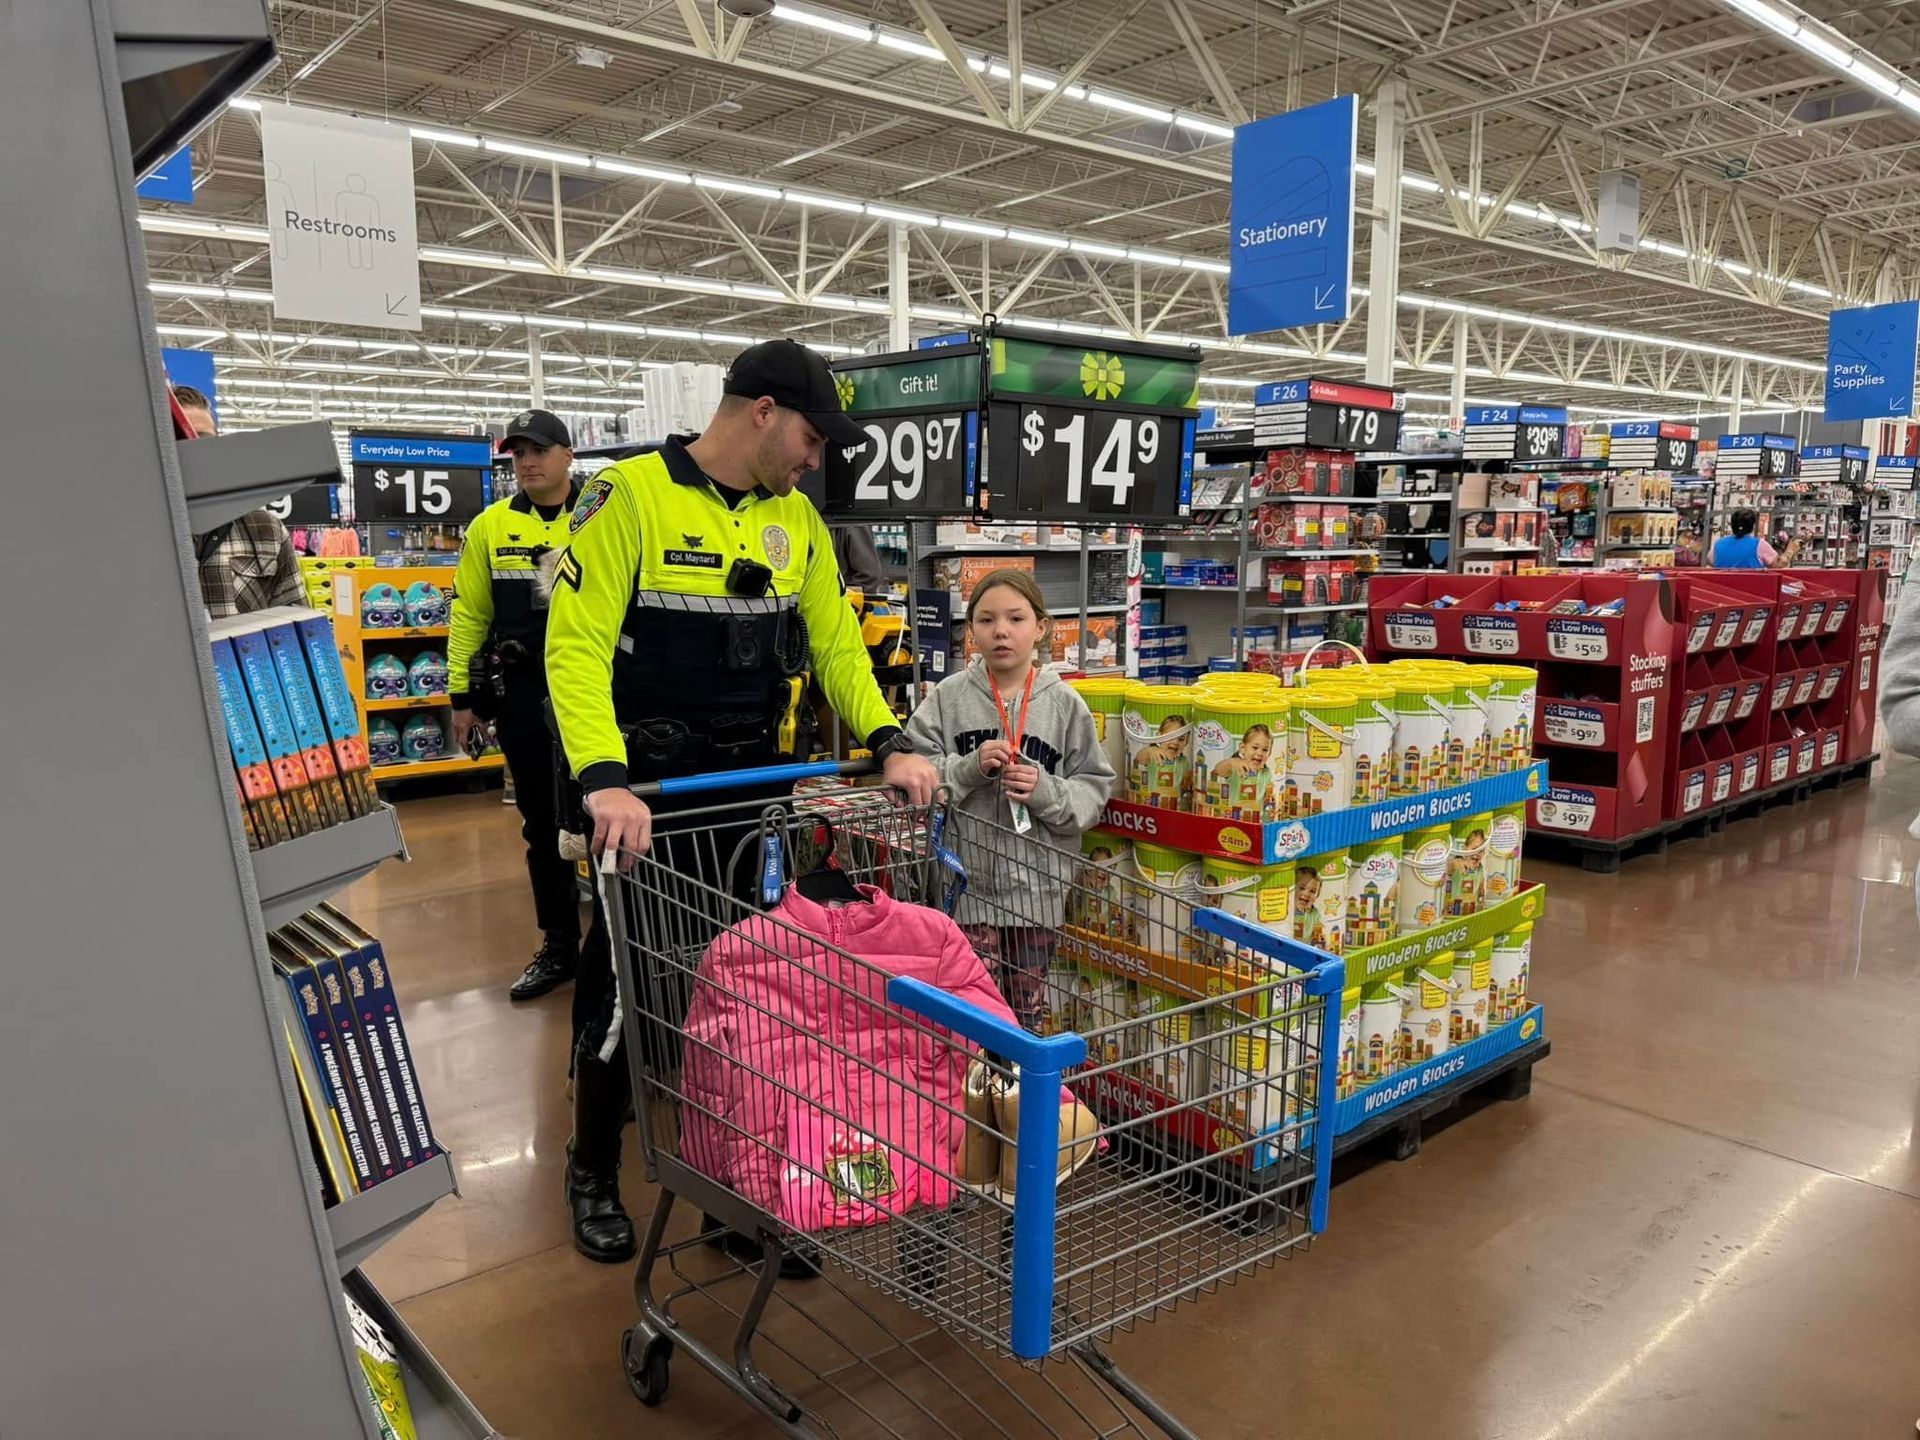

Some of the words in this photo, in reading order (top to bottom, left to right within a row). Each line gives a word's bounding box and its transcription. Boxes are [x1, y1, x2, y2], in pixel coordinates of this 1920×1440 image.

[285, 210, 396, 243] Restrooms
[1240, 217, 1328, 247] Stationery
[1834, 363, 1867, 376] Party
[900, 376, 923, 394] Gift
[925, 373, 938, 392] it!
[1833, 375, 1885, 390] Supplies
[1282, 384, 1298, 400] 26
[1481, 410, 1489, 422] F
[1492, 410, 1508, 421] 24
[1626, 424, 1634, 435] F
[1635, 424, 1649, 435] 22
[1732, 437, 1740, 447] F
[1741, 436, 1755, 446] 20
[360, 444, 404, 457] Everyday
[406, 446, 426, 456] Low
[427, 447, 450, 457] Price
[1814, 448, 1821, 456] F
[1822, 447, 1832, 456] 18
[1889, 458, 1897, 466] F
[1898, 457, 1906, 466] 16
[670, 552, 684, 563] Cpl.
[685, 553, 716, 564] Maynard
[1397, 616, 1413, 624] Low
[1414, 616, 1434, 625] Price
[1476, 620, 1493, 629] Low
[1494, 620, 1517, 630] Price
[1561, 623, 1580, 632] Low
[1582, 624, 1605, 634] Price
[1859, 623, 1879, 638] Stocking
[1859, 637, 1877, 653] stuffers
[1629, 651, 1667, 673] Stocking
[277, 650, 293, 685] LAURIE
[288, 686, 306, 727] GILMORE
[311, 641, 327, 675] LAURIE
[321, 676, 339, 727] GILMORE
[1630, 672, 1664, 693] stuffers
[246, 657, 262, 693] LAURIE
[258, 693, 277, 737] GILMORE
[1558, 708, 1577, 718] Low
[1578, 710, 1602, 721] Price
[223, 702, 243, 745] GILMORE
[1552, 790, 1570, 800] Low
[1571, 793, 1594, 804] Price
[1370, 804, 1425, 831] Wooden
[1220, 835, 1250, 848] 24m+
[767, 838, 777, 878] Walmart
[1366, 944, 1421, 974] Wooden
[388, 1020, 406, 1062] POKÉMON
[398, 1060, 418, 1105] STORYBOOK
[411, 1103, 431, 1149] COLLECTION
[345, 1037, 365, 1079] POKÉMON
[357, 1077, 379, 1122] STORYBOOK
[370, 1121, 391, 1166] COLLECTION
[368, 1029, 387, 1070] POKÉMON
[379, 1069, 400, 1114] STORYBOOK
[391, 1113, 412, 1158] COLLECTION
[1364, 1077, 1418, 1113] Wooden
[322, 1047, 343, 1089] POKÉMON
[335, 1088, 357, 1133] STORYBOOK
[349, 1131, 371, 1177] COLLECTION
